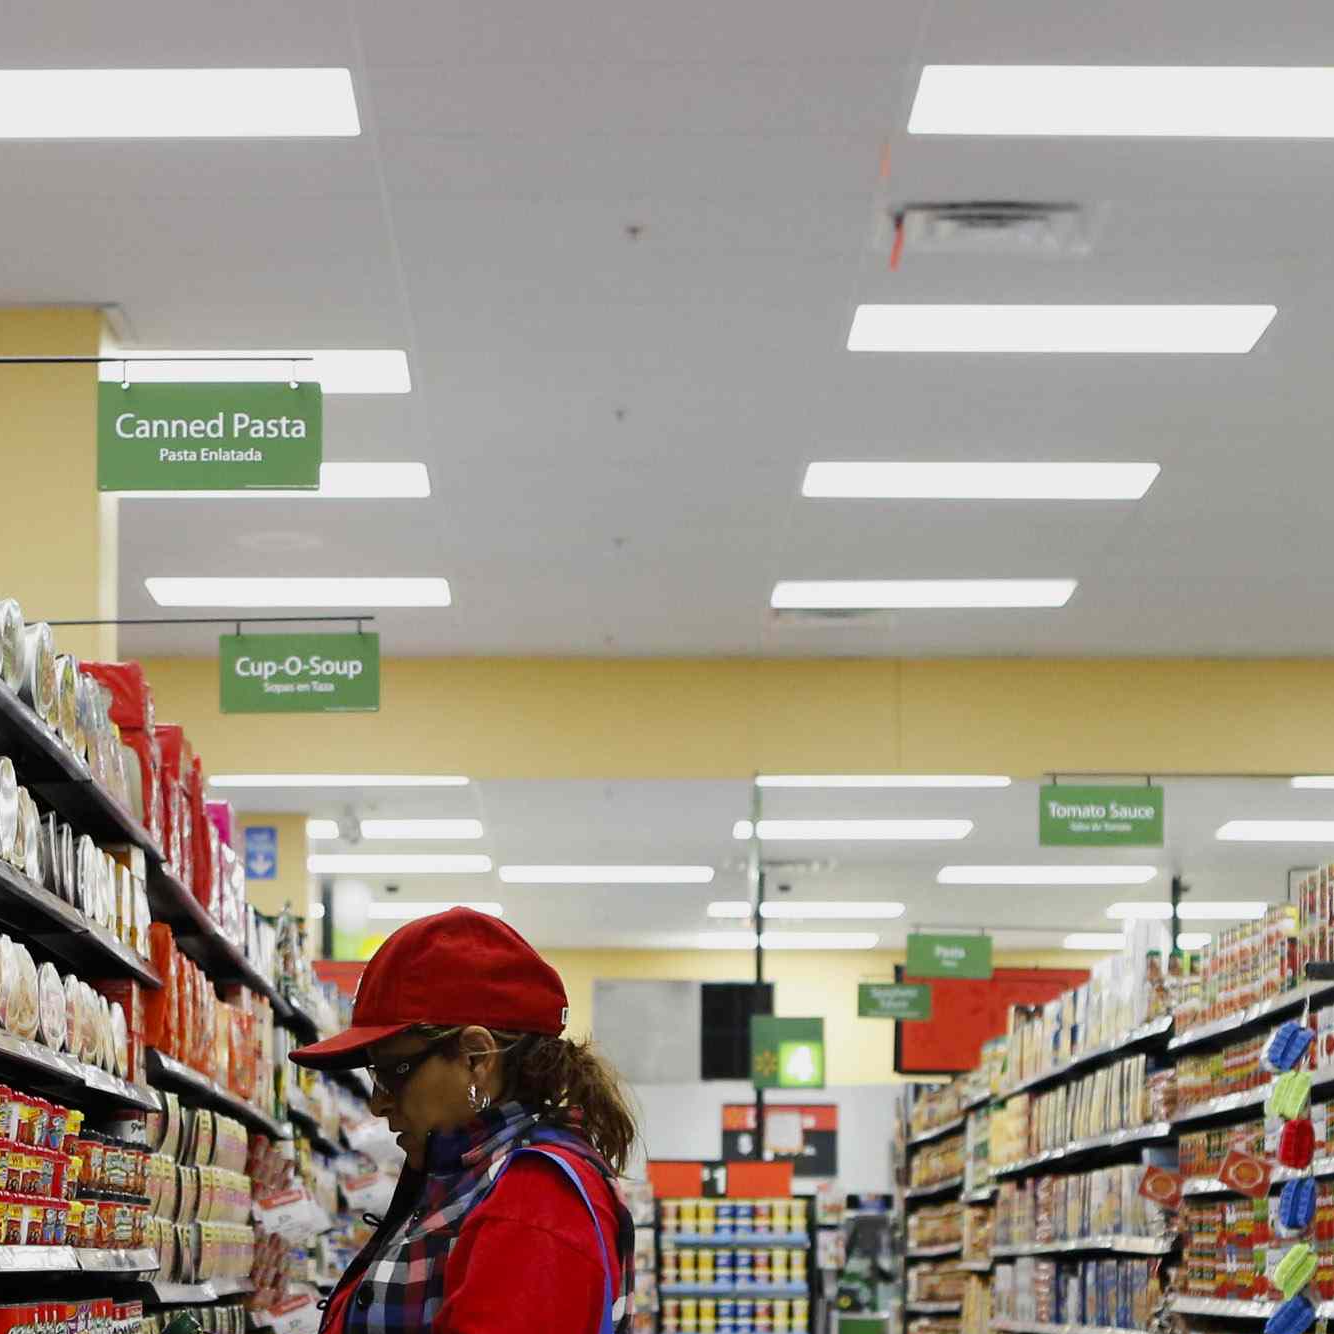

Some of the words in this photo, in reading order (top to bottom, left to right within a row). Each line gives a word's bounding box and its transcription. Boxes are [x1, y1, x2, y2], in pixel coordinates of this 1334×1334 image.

[115, 412, 224, 439] Canned
[232, 412, 306, 439] Pasta
[159, 448, 197, 462] Pasta
[200, 448, 262, 462] Enlatada
[235, 656, 363, 680] Cup-O-Soup
[1048, 802, 1106, 820] Tomato
[1109, 802, 1155, 820] Sauce
